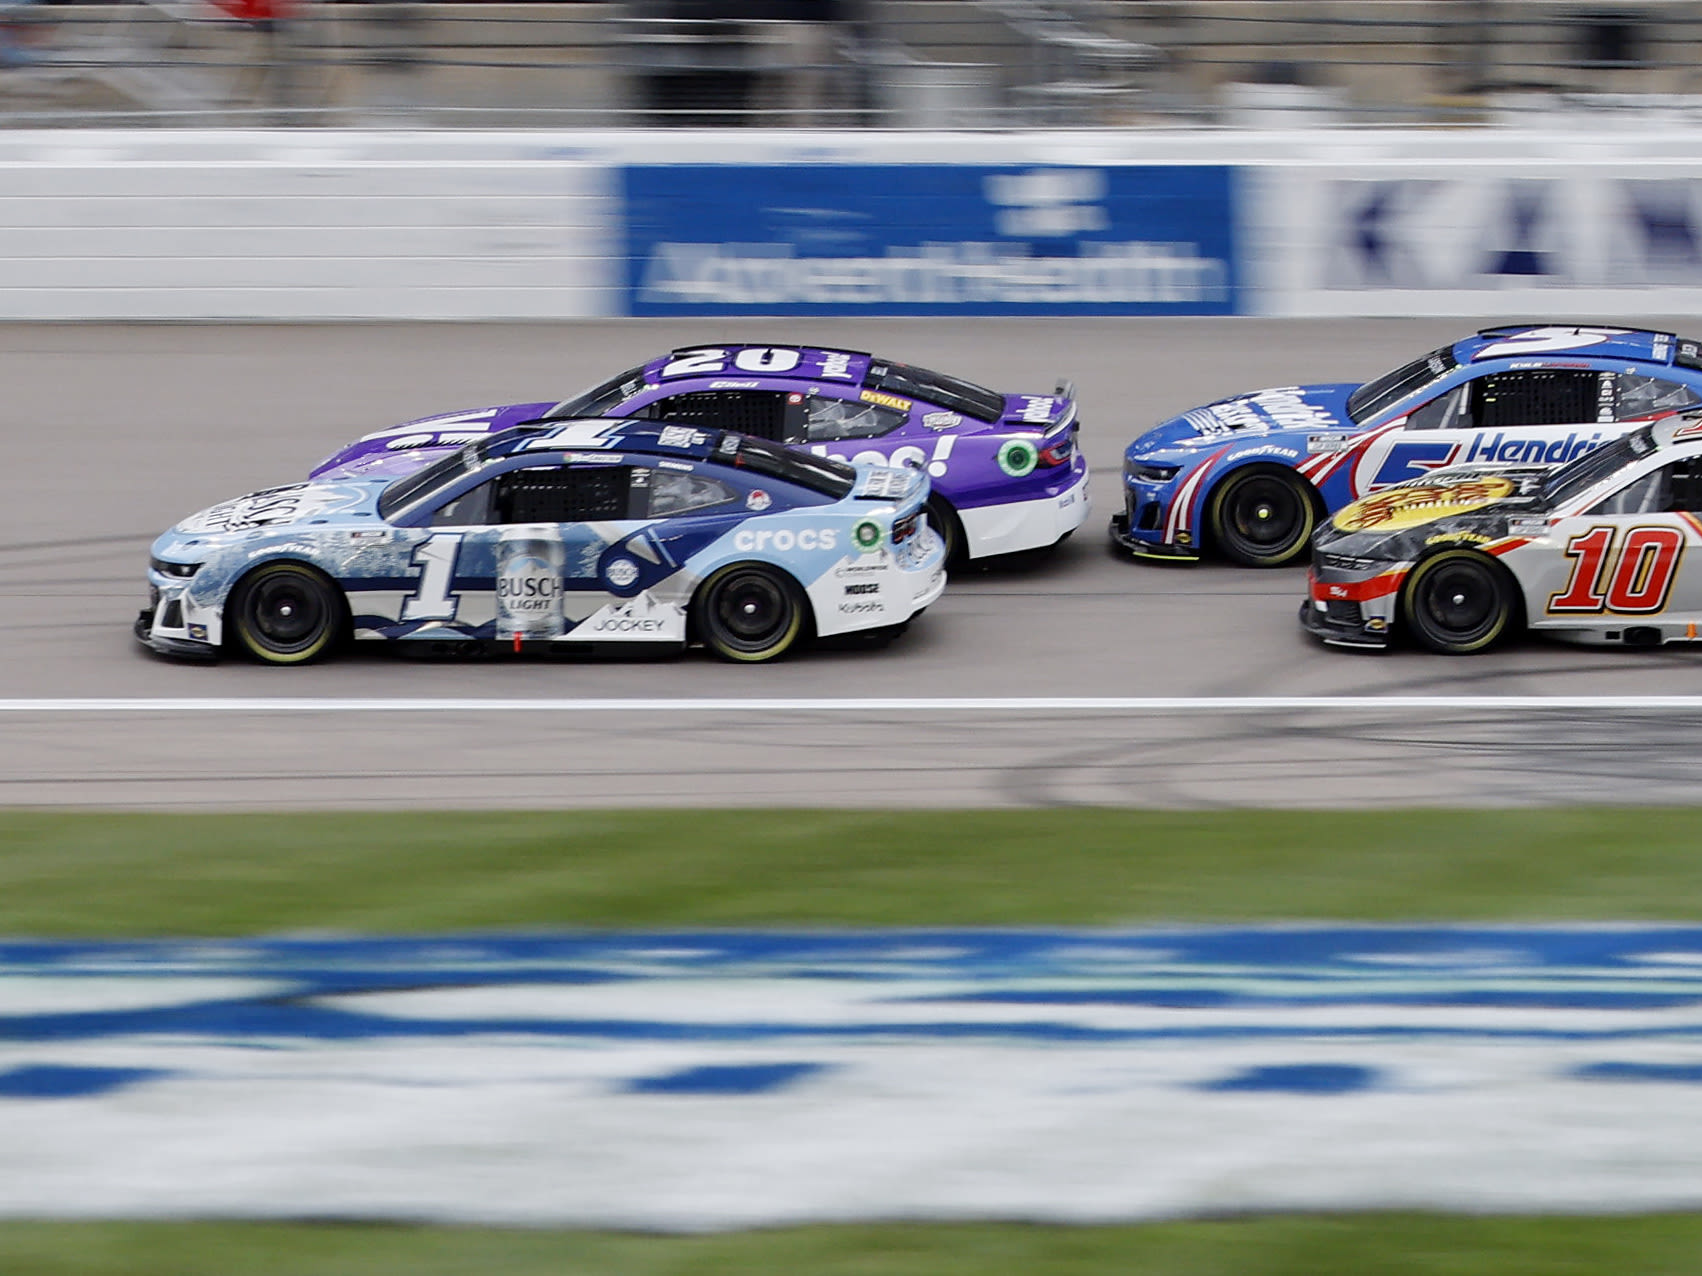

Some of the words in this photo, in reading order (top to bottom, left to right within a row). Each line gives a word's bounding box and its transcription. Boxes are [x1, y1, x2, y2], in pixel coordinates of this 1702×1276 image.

[1471, 326, 1638, 360] 5
[661, 348, 801, 377] 20
[513, 420, 638, 452] 1
[1466, 432, 1630, 463] Hendri
[1227, 445, 1299, 462] GOODYEAR
[1365, 438, 1464, 494] 5
[734, 528, 837, 551] crocs
[400, 531, 465, 622] 1
[1548, 525, 1685, 616] 10
[500, 577, 561, 599] BUSCH
[510, 600, 550, 610] LIGHT
[594, 619, 666, 632] JOCKEY
